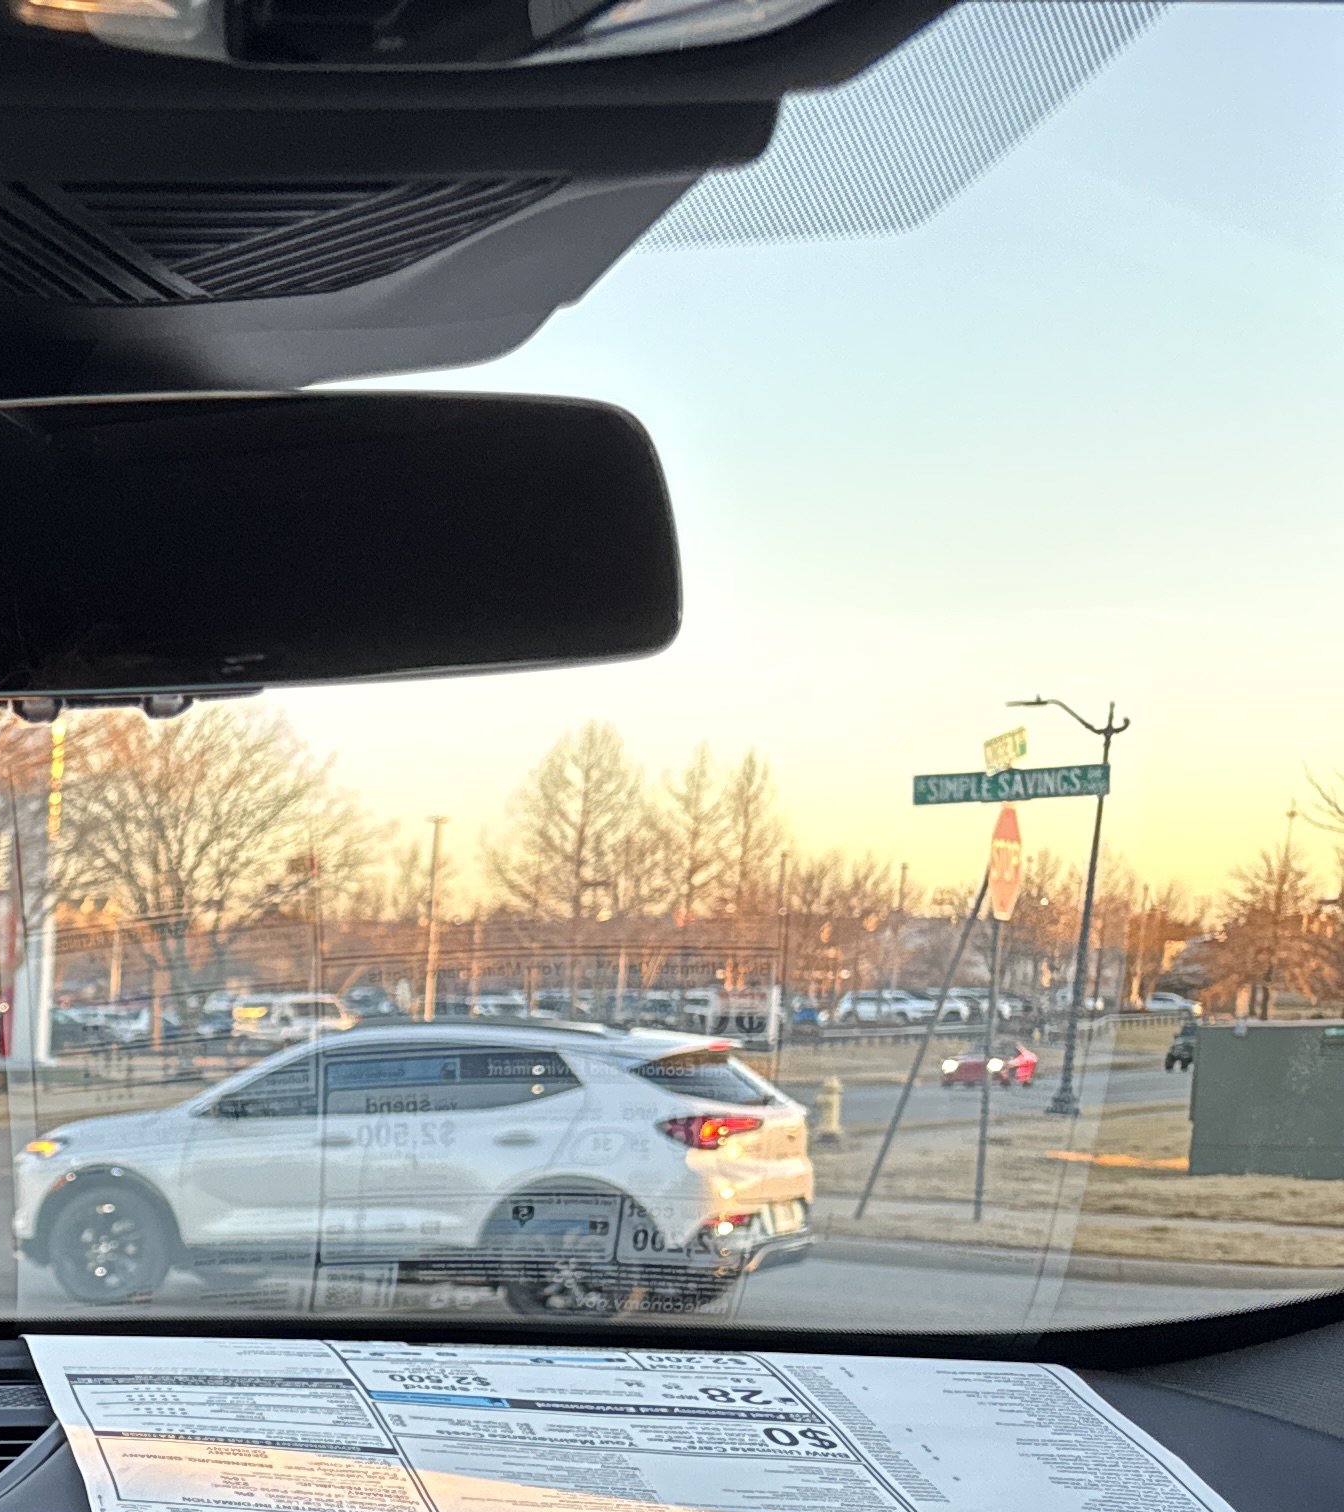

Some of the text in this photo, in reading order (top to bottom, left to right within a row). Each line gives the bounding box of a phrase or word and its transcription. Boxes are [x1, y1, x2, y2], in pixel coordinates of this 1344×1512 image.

[927, 776, 992, 802] SIMPLE
[998, 767, 1081, 799] SAVINGS
[698, 1387, 773, 1405] 28
[762, 1427, 838, 1450] $0
